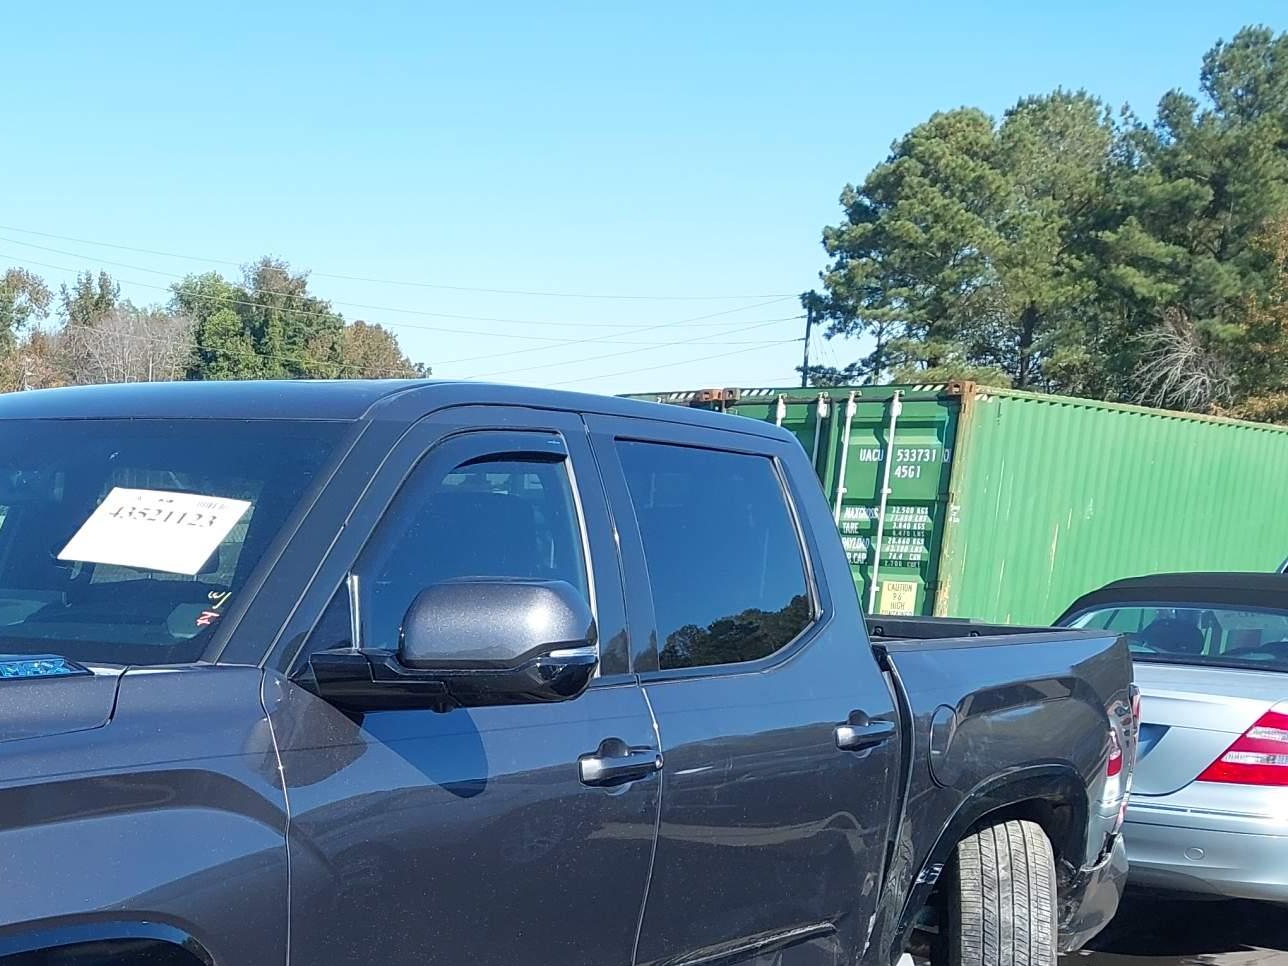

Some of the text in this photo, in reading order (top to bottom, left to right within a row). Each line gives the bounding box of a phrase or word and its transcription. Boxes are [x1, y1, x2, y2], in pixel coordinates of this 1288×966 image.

[859, 448, 884, 462] UACU
[896, 448, 936, 462] 533731
[894, 465, 921, 478] 45G1
[109, 505, 217, 528] 43521123
[842, 522, 860, 534] TARE
[887, 583, 913, 592] CAUTION
[890, 601, 905, 610] HIGH
